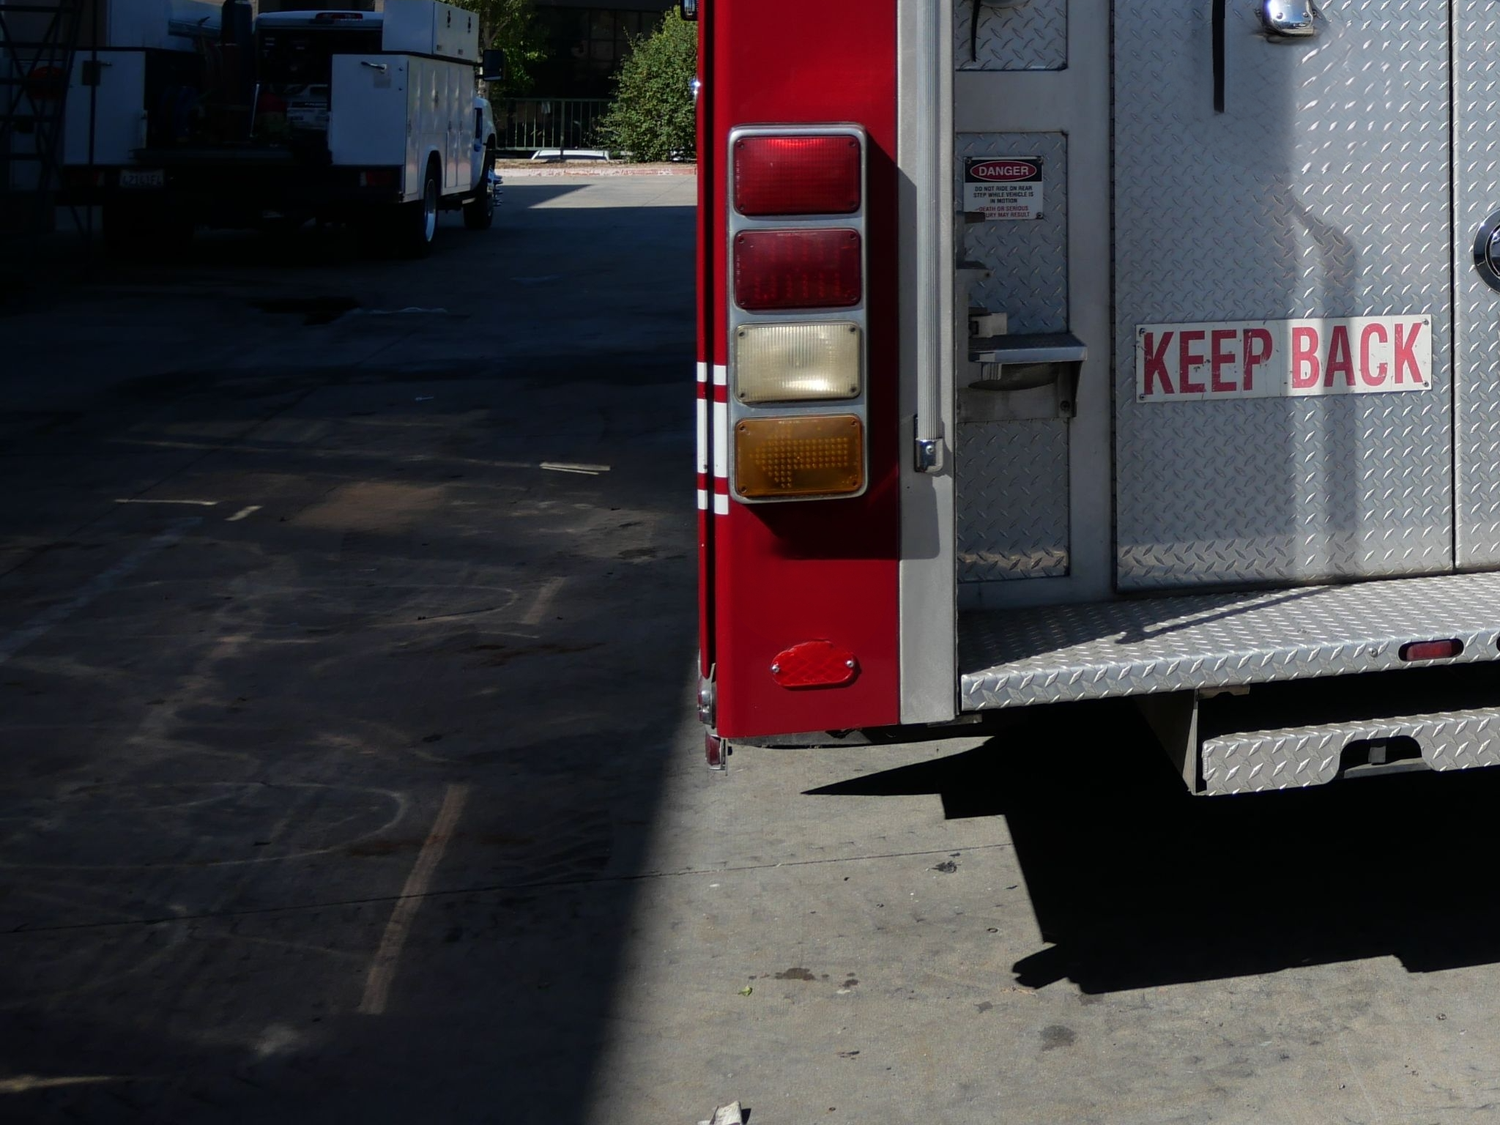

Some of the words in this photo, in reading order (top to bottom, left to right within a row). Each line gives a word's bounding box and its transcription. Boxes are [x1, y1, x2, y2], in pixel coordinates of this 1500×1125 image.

[978, 166, 1029, 176] DANGER
[1143, 328, 1273, 395] KEEP
[1291, 322, 1423, 389] BACK
